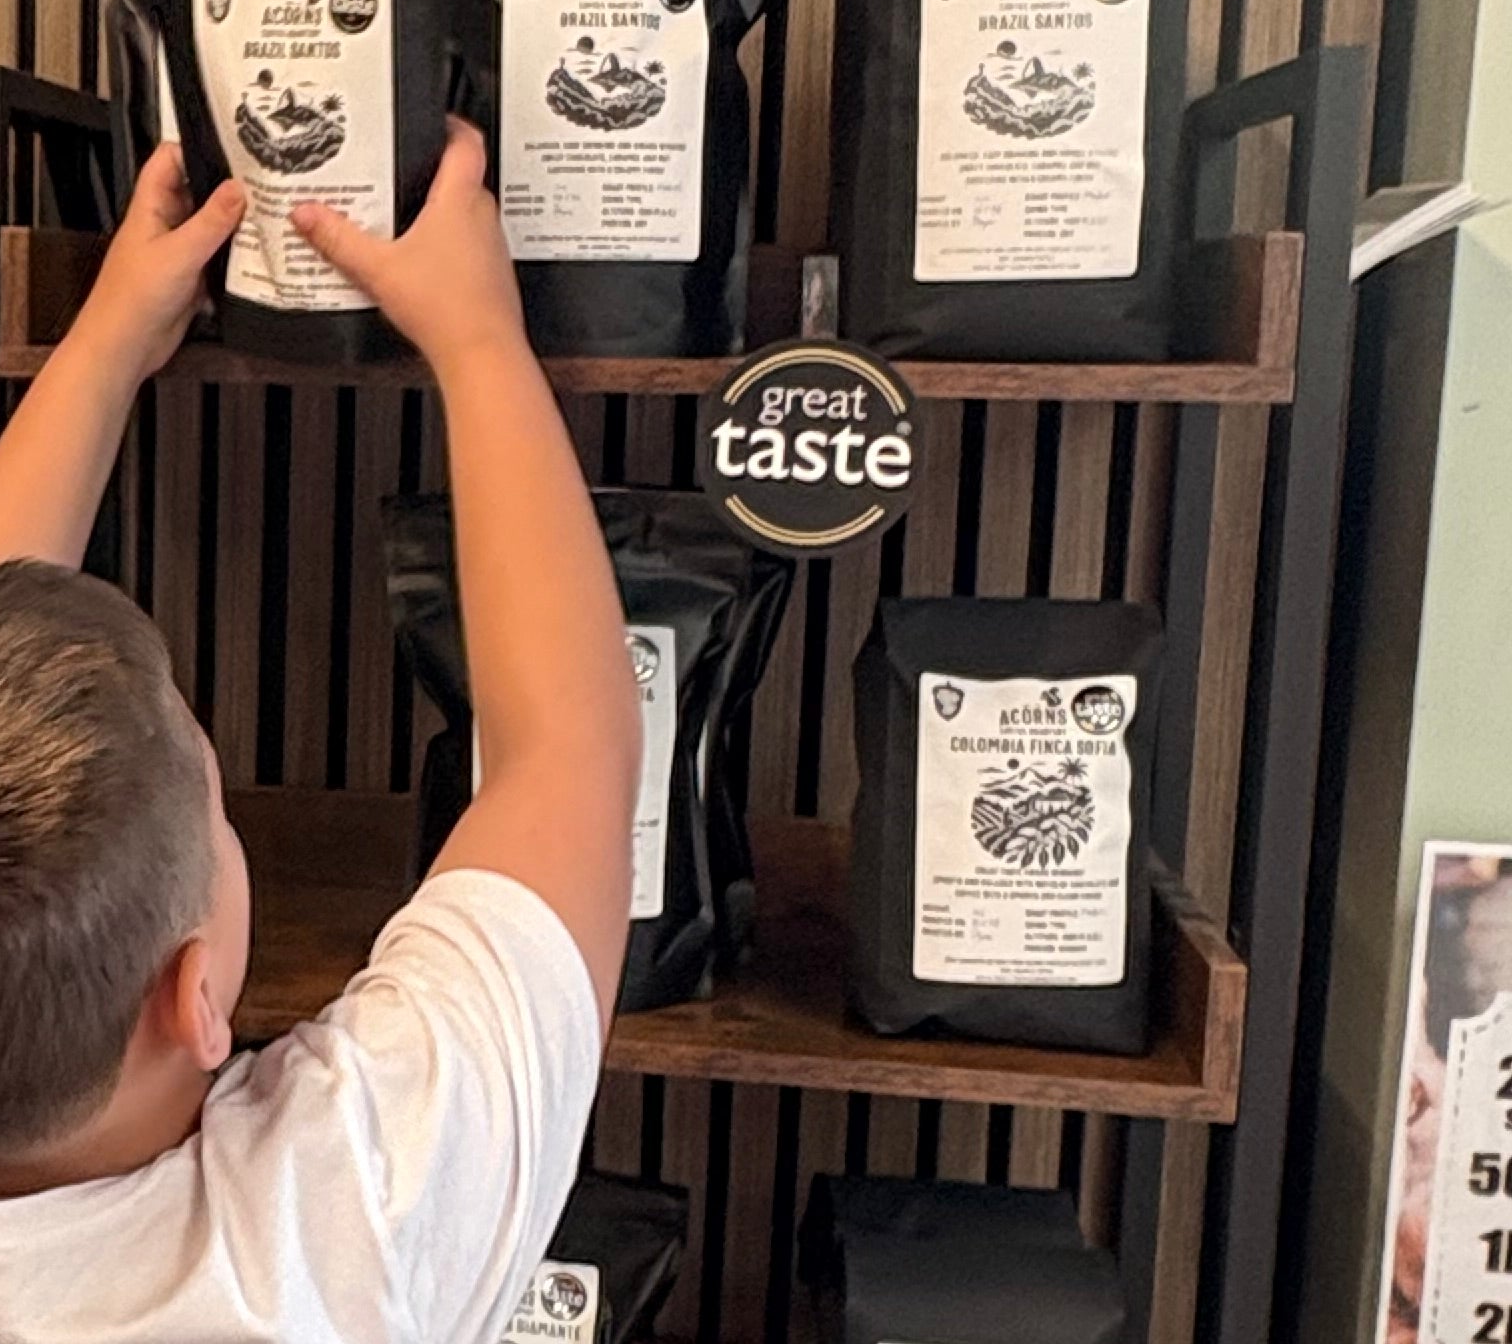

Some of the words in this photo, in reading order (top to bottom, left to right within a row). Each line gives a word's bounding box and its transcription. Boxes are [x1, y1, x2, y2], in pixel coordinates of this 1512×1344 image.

[560, 13, 607, 28] BRAZIL
[979, 14, 1030, 31] BRAZIL
[1034, 13, 1093, 29] SANTOS
[758, 384, 868, 425] great
[711, 418, 912, 488] taste
[999, 709, 1067, 725] ACORNS
[950, 736, 1024, 753] COLOMBIA
[1030, 738, 1072, 754] FINCA
